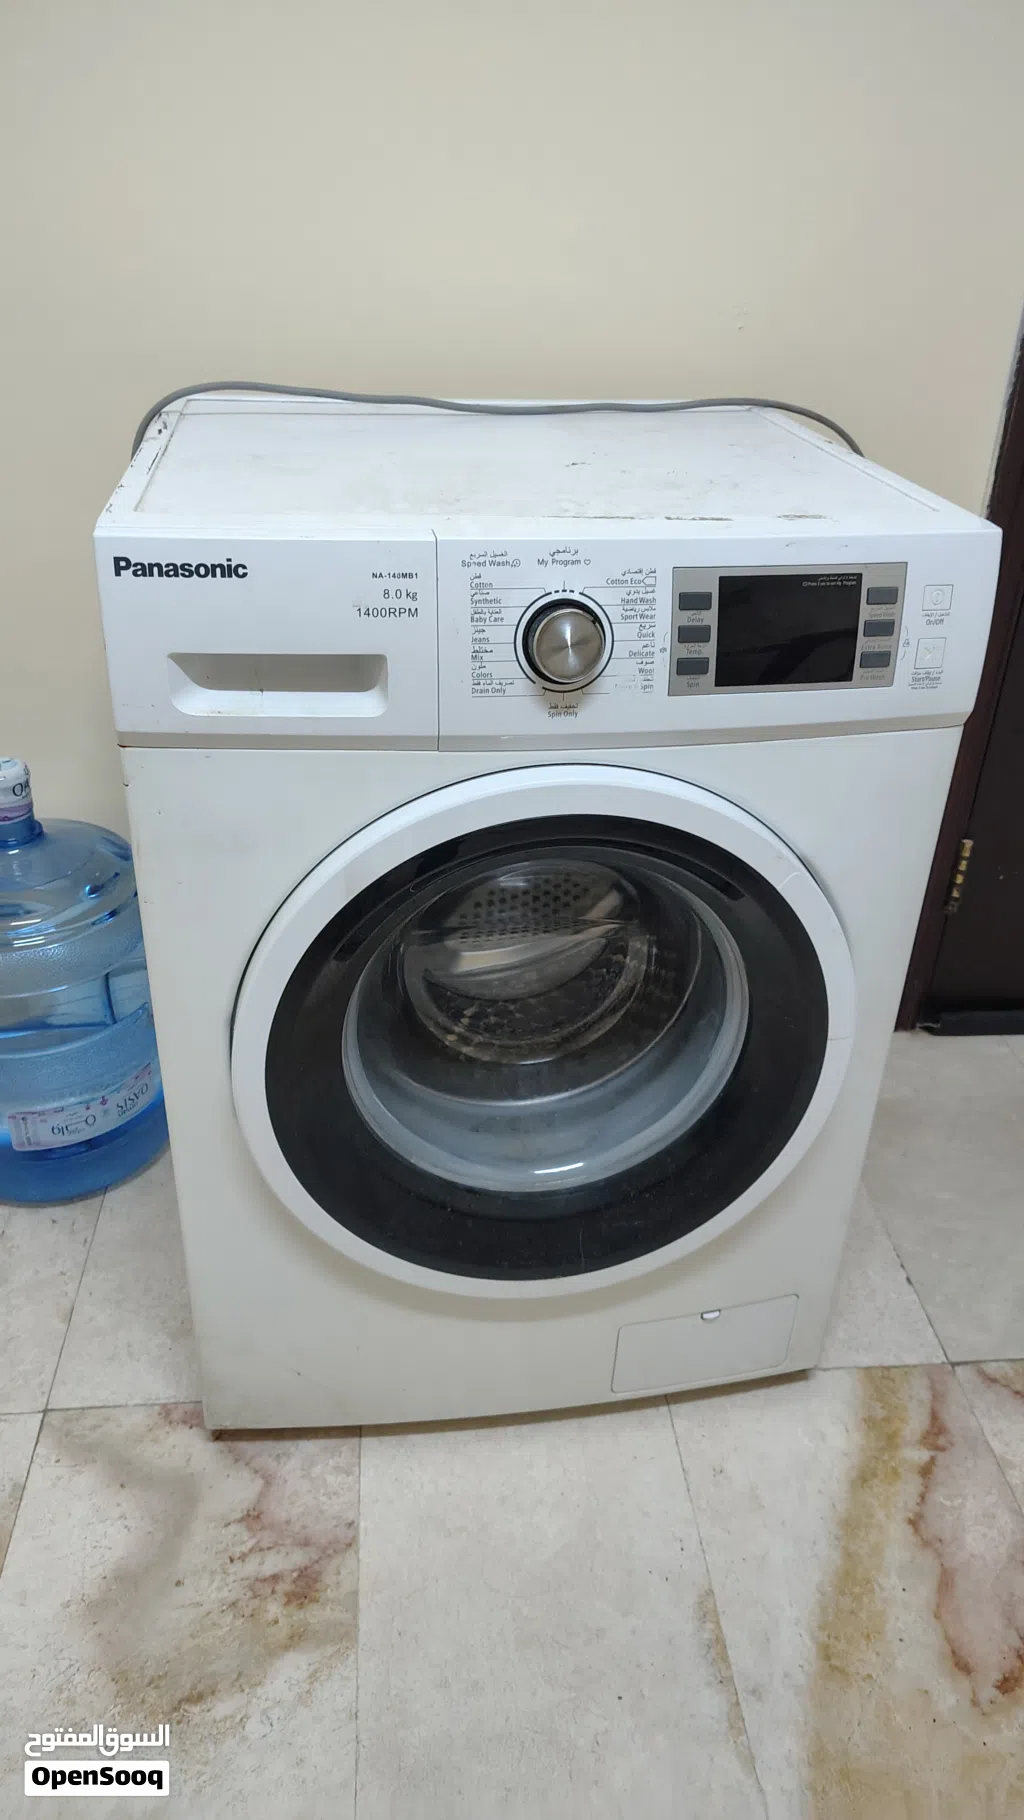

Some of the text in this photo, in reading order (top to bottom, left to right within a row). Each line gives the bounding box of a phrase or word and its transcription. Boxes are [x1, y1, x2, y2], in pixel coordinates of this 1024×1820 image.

[549, 546, 579, 557] برنامجي
[488, 559, 511, 567] Wash
[537, 558, 581, 568] My Program
[112, 556, 249, 579] Panasonic
[605, 577, 629, 585] Cotton
[383, 588, 418, 602] 8.0 kg
[470, 597, 502, 607] Synthetic
[639, 595, 657, 604] Wash
[356, 607, 418, 618] 1400RPM
[470, 616, 487, 624] Baby
[620, 613, 638, 621] Sport
[687, 616, 704, 624] Delay
[925, 618, 945, 626] On/Off
[637, 631, 656, 639] Quick
[686, 648, 704, 656] Temp.
[911, 675, 941, 683] Start/Pause
[491, 687, 507, 695] Only
[563, 710, 579, 718] Only
